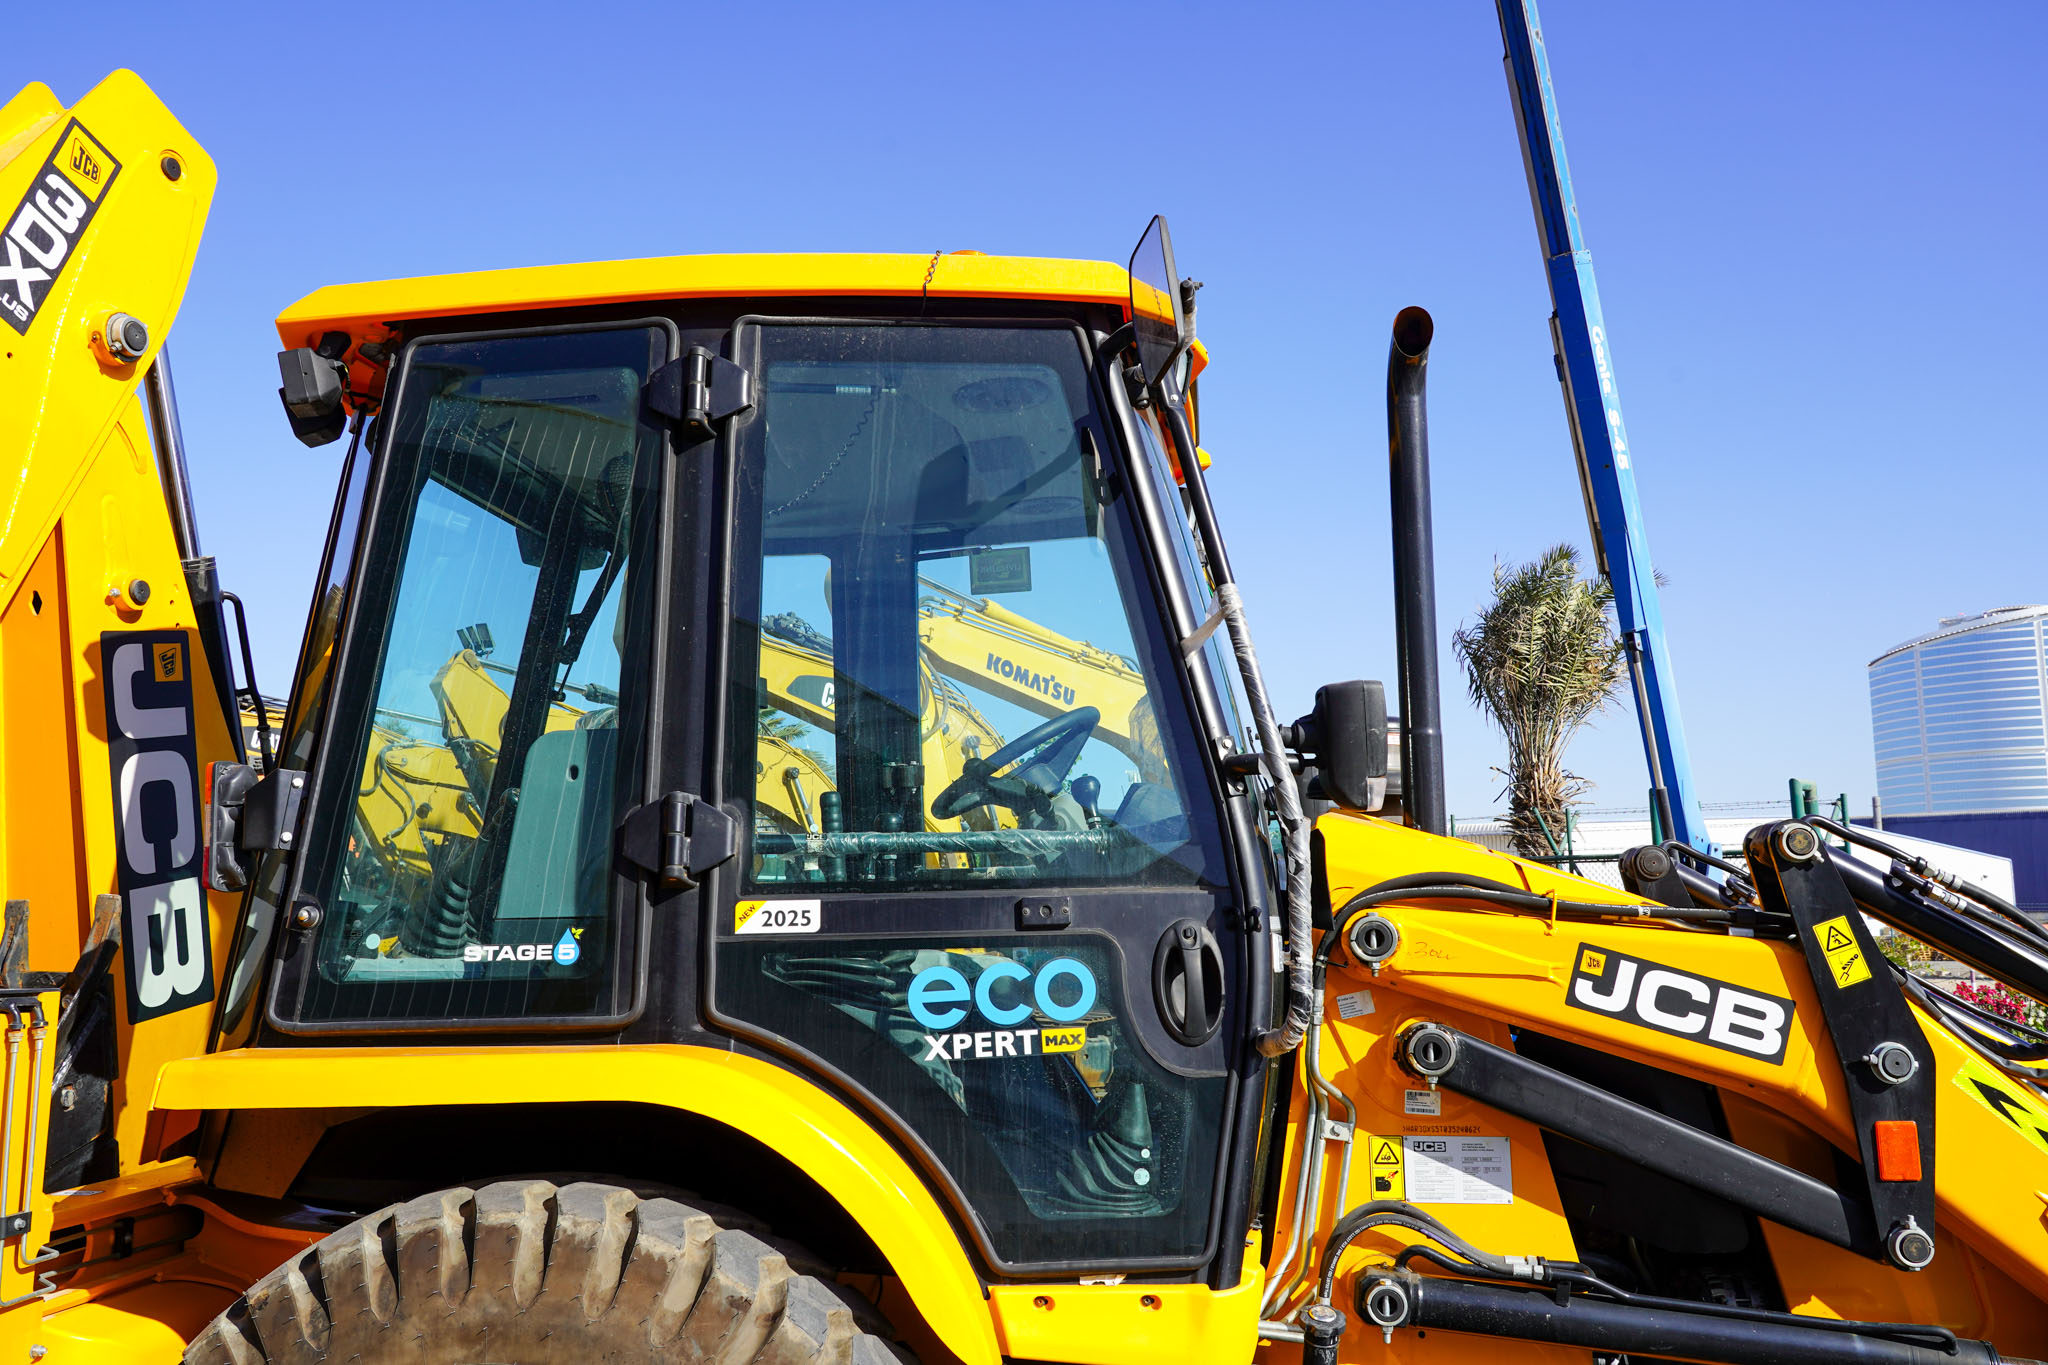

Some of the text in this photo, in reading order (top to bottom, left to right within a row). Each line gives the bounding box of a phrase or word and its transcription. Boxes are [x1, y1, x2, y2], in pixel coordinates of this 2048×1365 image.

[74, 145, 98, 182] JCB
[1592, 325, 1629, 470] Genie S-45
[161, 648, 176, 678] JCB
[986, 652, 1075, 706] KOMATSU
[112, 643, 205, 1008] JCB
[738, 904, 811, 927] NEW 2025
[464, 944, 576, 961] STAGE 5
[1587, 954, 1601, 968] JCB
[907, 957, 1097, 1030] eco
[1575, 961, 1785, 1056] JCB
[924, 1029, 1083, 1061] XPERT MAX
[1414, 1141, 1446, 1152] JCB
